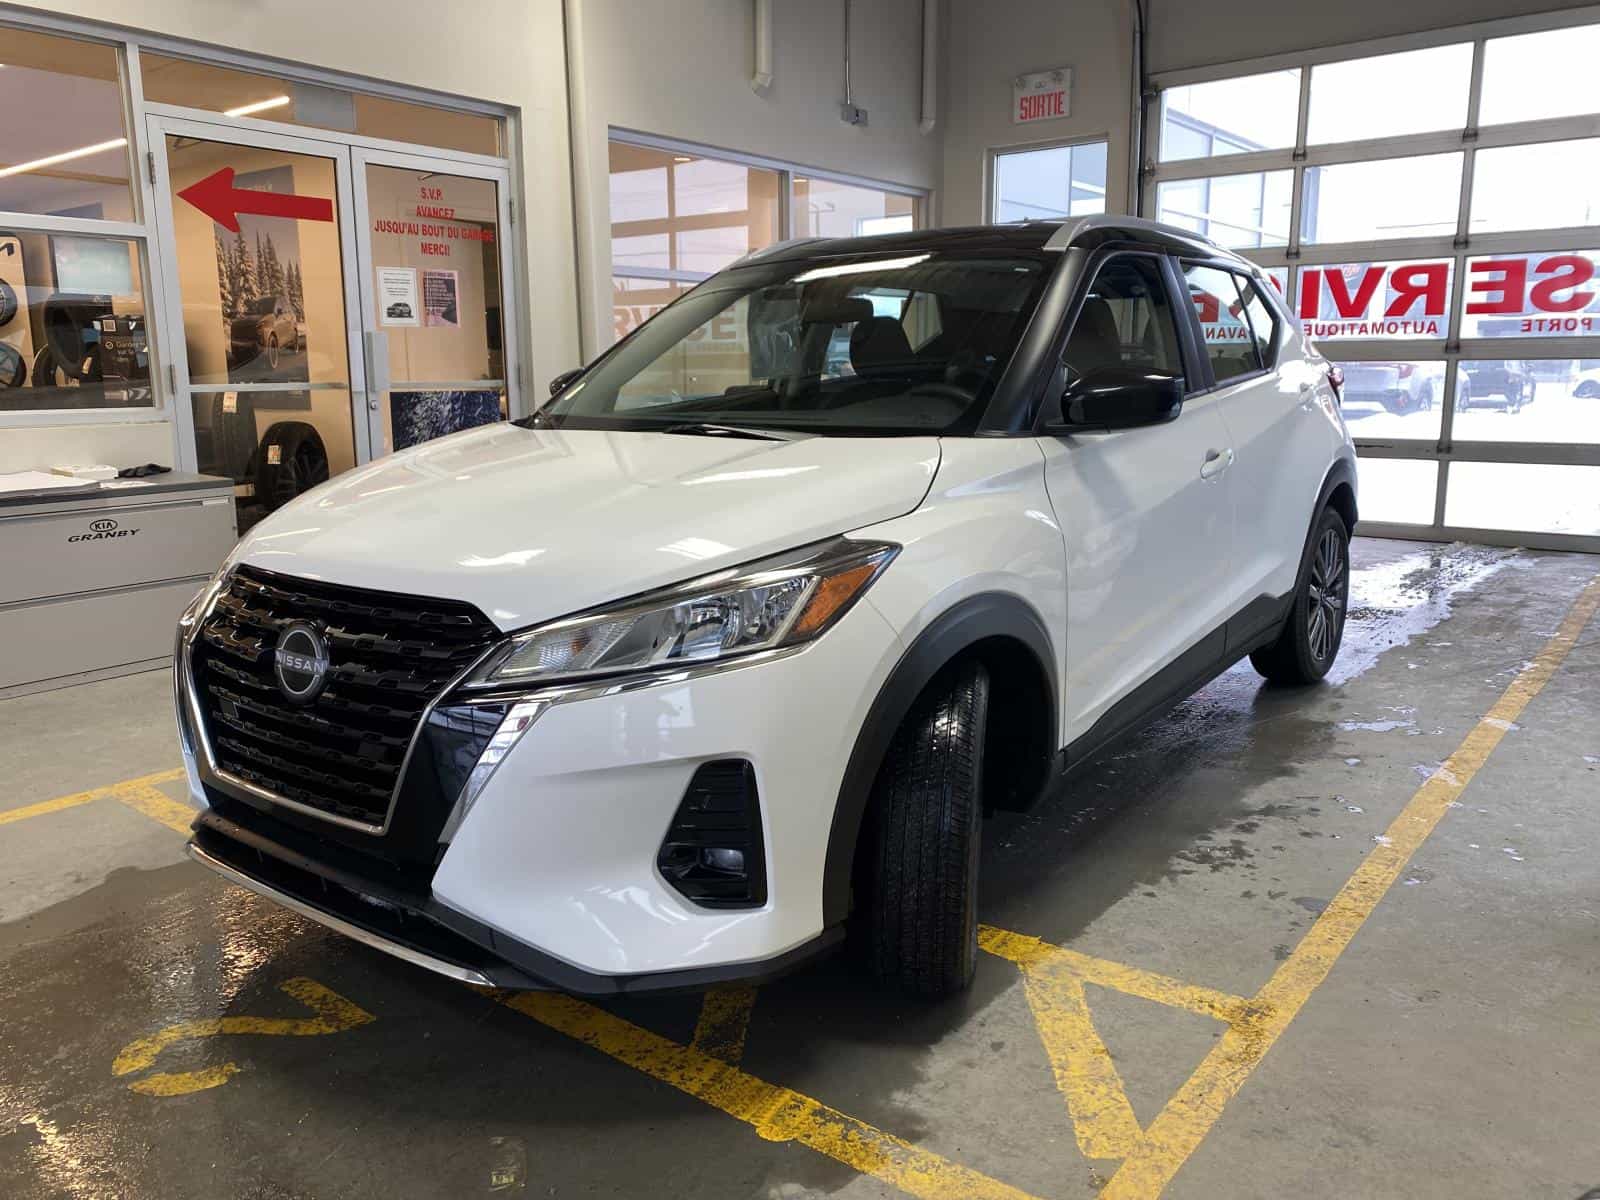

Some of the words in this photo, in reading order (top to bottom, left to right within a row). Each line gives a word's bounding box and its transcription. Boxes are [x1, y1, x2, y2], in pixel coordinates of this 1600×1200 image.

[1019, 91, 1065, 121] SORTIE
[416, 205, 456, 219] AVANCEZ
[374, 220, 419, 235] JUSQU'AU
[422, 223, 445, 238] BOUT
[447, 226, 459, 241] DU
[94, 521, 114, 530] KIA
[67, 528, 141, 543] GRANBY
[275, 650, 325, 673] NISSAN
